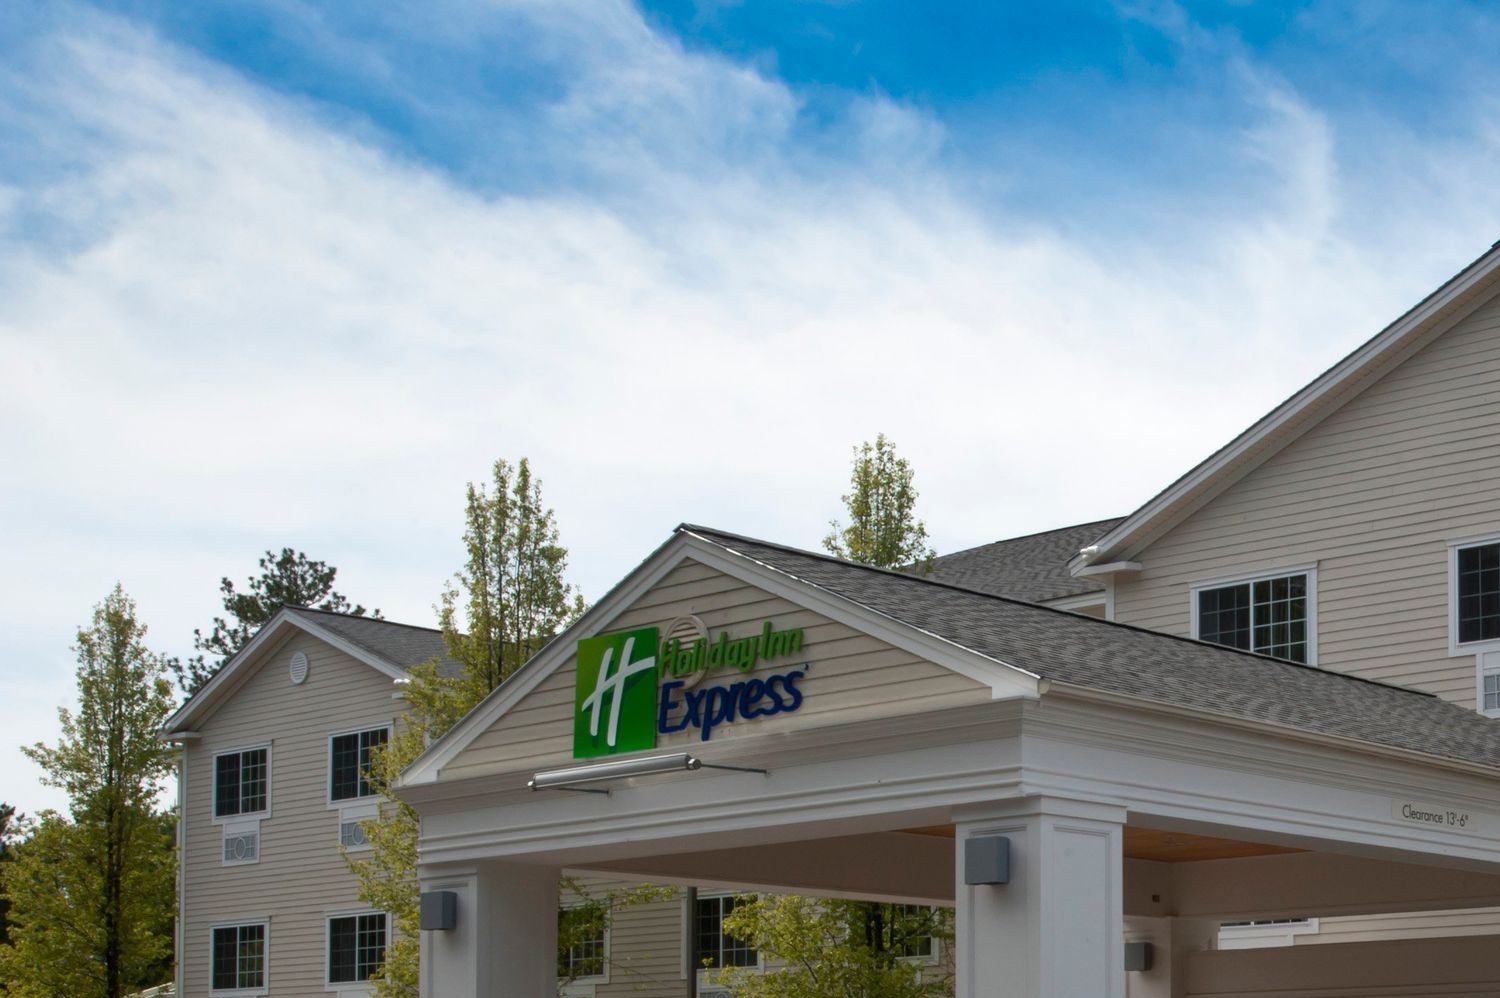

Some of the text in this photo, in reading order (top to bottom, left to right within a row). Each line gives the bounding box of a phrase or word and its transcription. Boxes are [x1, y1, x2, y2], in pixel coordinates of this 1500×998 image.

[658, 622, 804, 677] Holiday Inn
[582, 637, 655, 746] H
[659, 671, 804, 741] Express
[1403, 804, 1443, 823] Clearance
